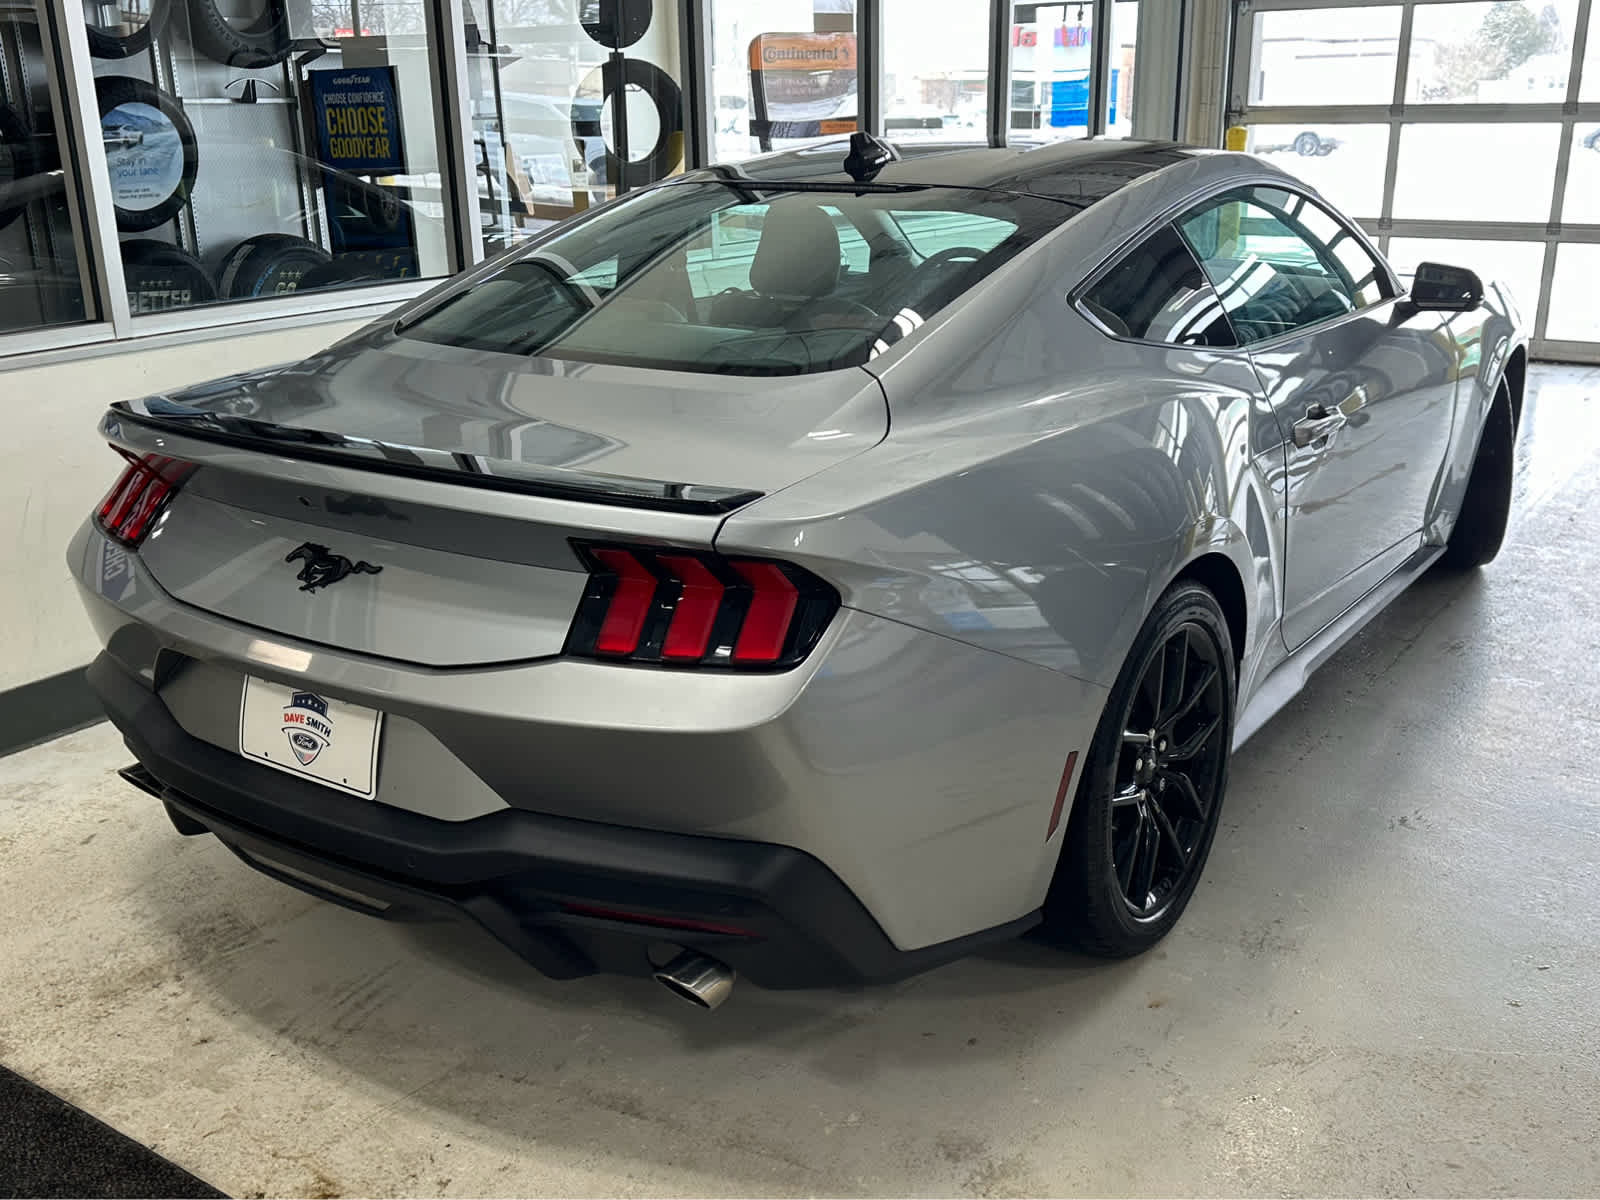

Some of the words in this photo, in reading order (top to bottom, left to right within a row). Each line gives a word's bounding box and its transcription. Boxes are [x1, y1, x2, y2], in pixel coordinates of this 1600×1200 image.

[762, 45, 838, 63] Continental
[332, 74, 371, 85] GOODYEAR
[323, 93, 347, 105] CHOOSE
[348, 91, 384, 104] CONFIDENCE
[326, 106, 388, 135] CHOOSE
[330, 137, 391, 158] GOODYEAR
[117, 157, 135, 168] Stay
[117, 167, 138, 178] your
[140, 167, 160, 177] lane
[128, 290, 192, 312] BETTER
[284, 713, 305, 724] DAVE
[305, 716, 331, 738] SMITH
[296, 735, 314, 748] Ford
